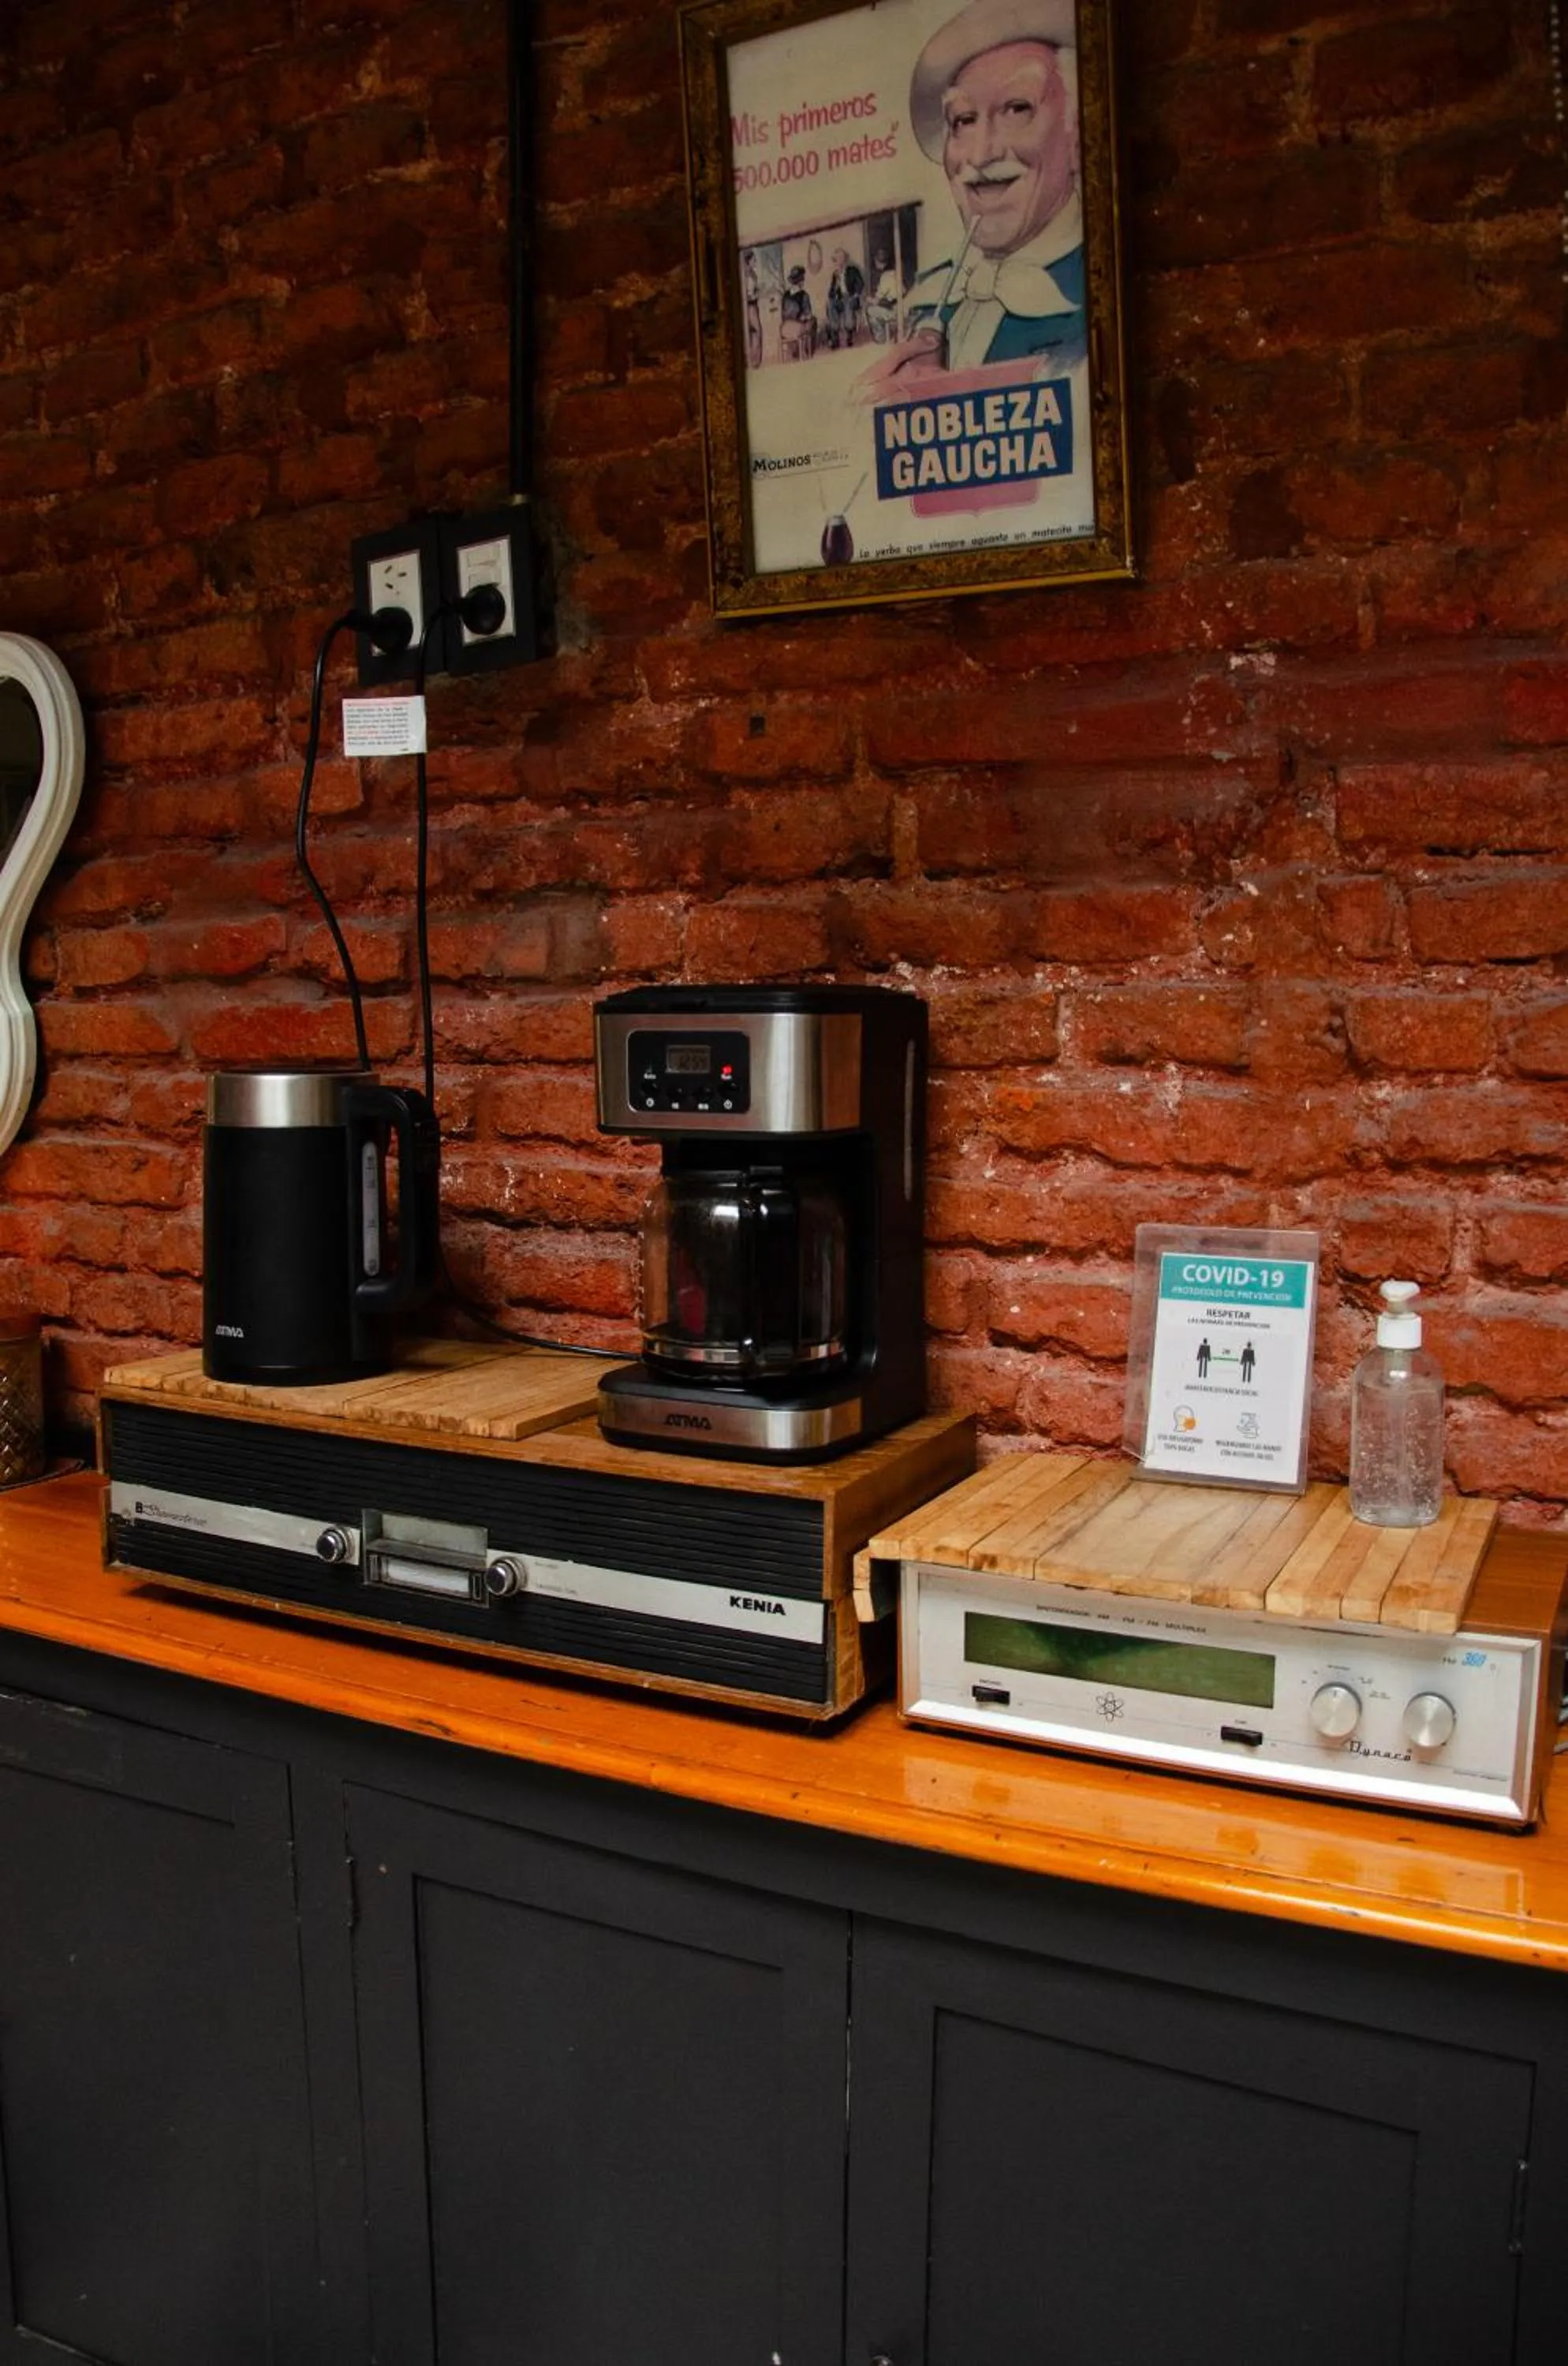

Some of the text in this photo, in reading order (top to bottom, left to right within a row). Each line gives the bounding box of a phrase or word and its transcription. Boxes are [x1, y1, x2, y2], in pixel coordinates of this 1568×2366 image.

[731, 92, 877, 148] Mis primeros
[883, 387, 1063, 450] NOBLEZA
[752, 453, 812, 472] MOLINOS
[892, 431, 1058, 490] GAUCHA
[875, 543, 901, 557] yerba
[907, 543, 924, 555] que
[929, 539, 965, 553] siempre
[1183, 1263, 1285, 1289] COVID-19
[1206, 1308, 1251, 1319] RESPETAR
[215, 1325, 244, 1338] ATMA
[664, 1413, 713, 1430] ATMA
[730, 1595, 786, 1616] KENIA
